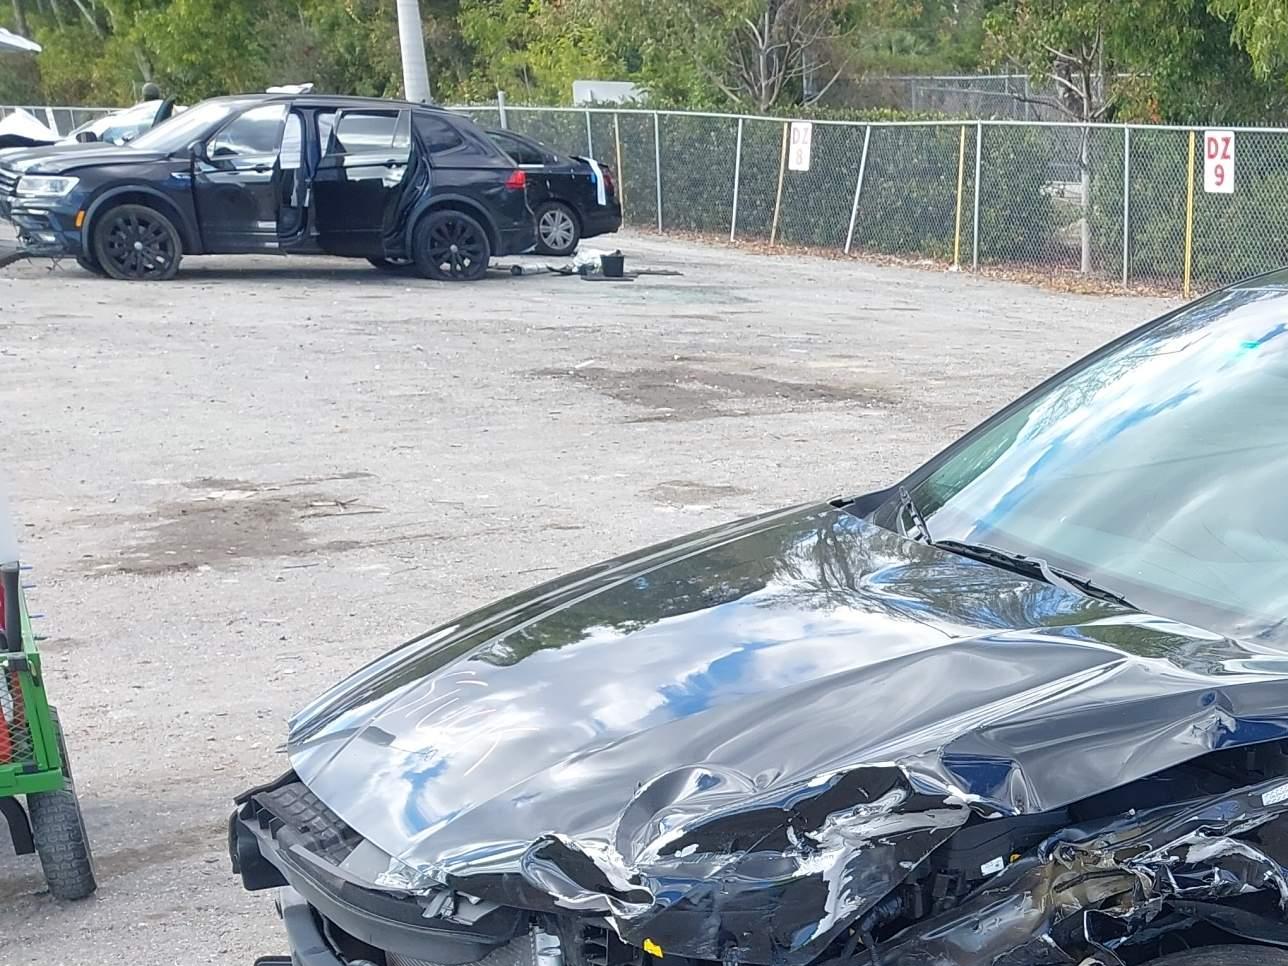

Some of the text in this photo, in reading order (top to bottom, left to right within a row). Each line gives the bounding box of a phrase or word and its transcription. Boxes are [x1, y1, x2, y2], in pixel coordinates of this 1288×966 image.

[792, 127, 809, 145] DZ
[1207, 136, 1232, 160] DZ
[1214, 164, 1225, 186] 9
